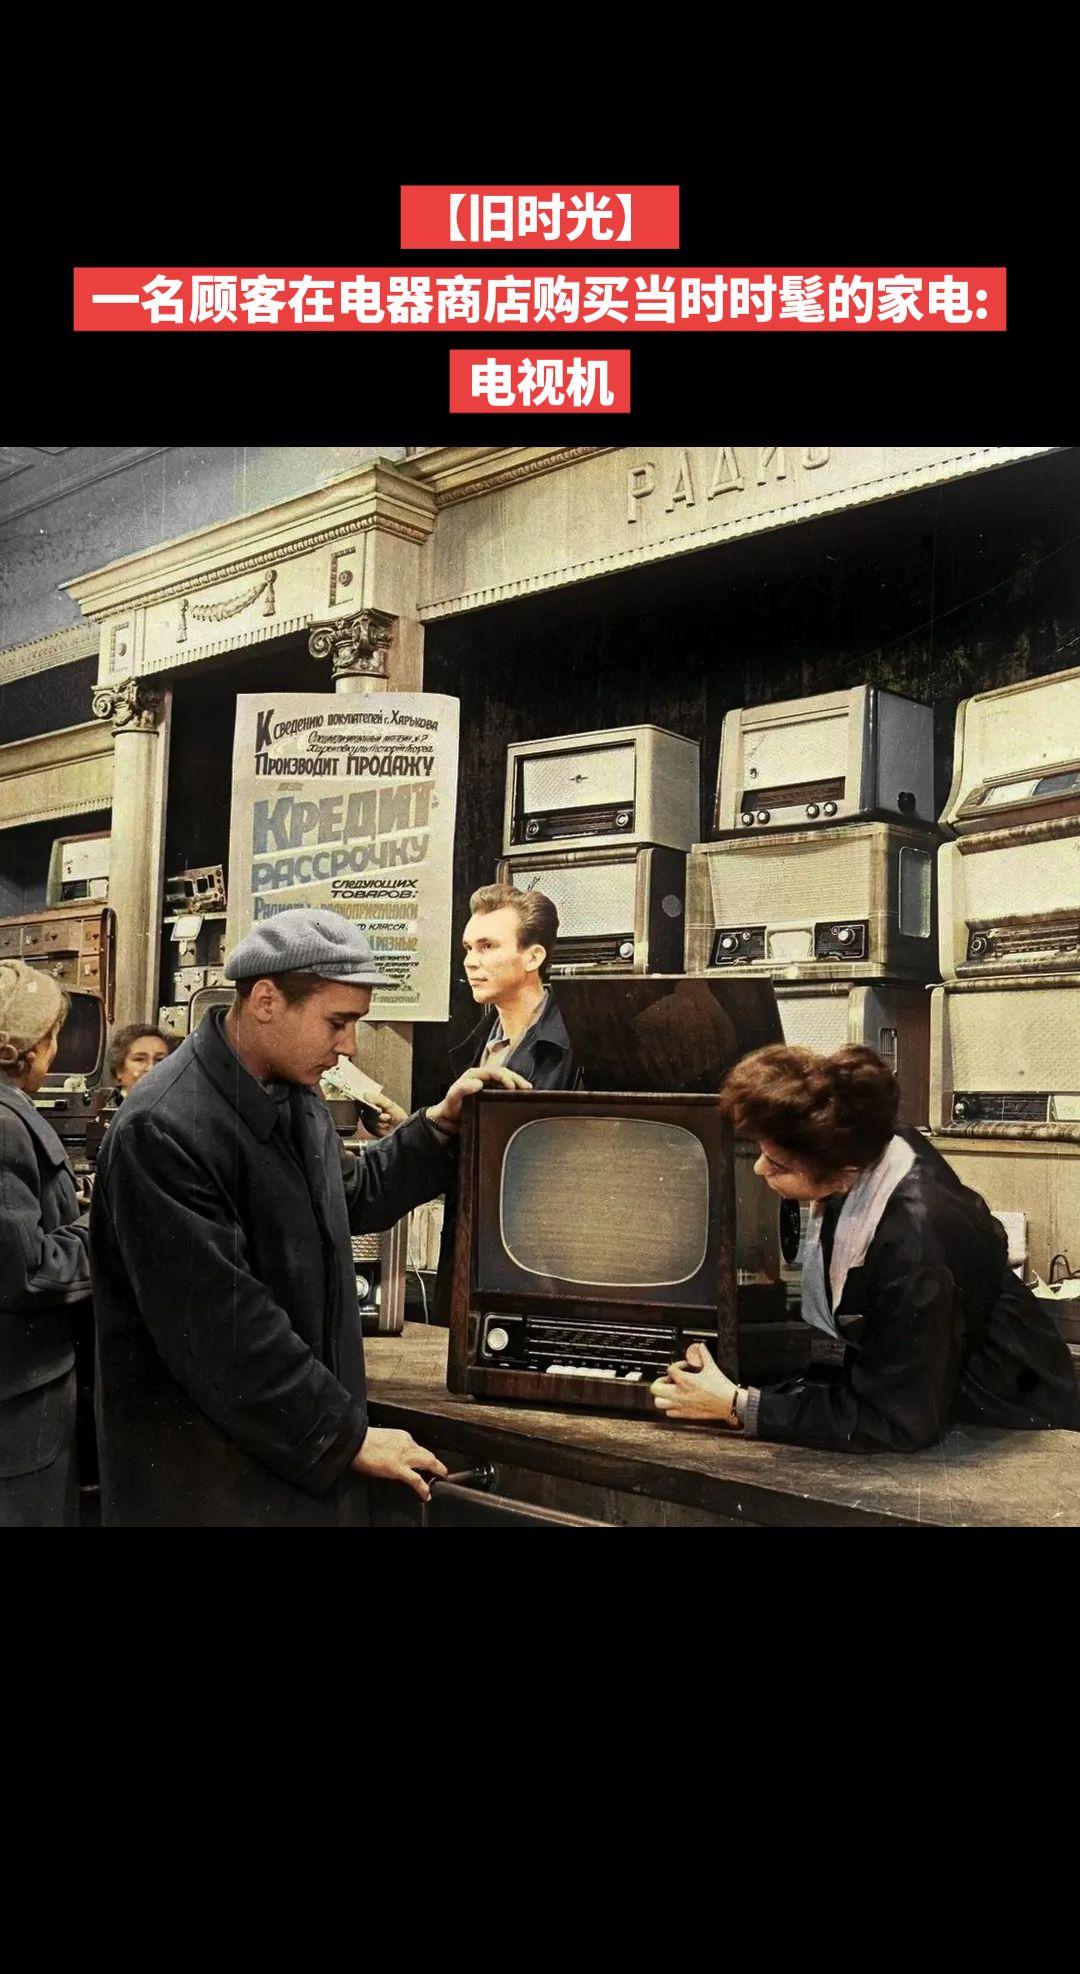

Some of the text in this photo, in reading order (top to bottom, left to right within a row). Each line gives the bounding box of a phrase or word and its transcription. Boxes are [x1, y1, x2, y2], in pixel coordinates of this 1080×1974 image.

[255, 709, 274, 752] К
[346, 755, 435, 777] ПРОДАЖУ
[252, 780, 435, 854] КРЕДИТ
[251, 834, 429, 893] РАССРОЧКУ
[331, 890, 418, 899] ТОВАРОВ:
